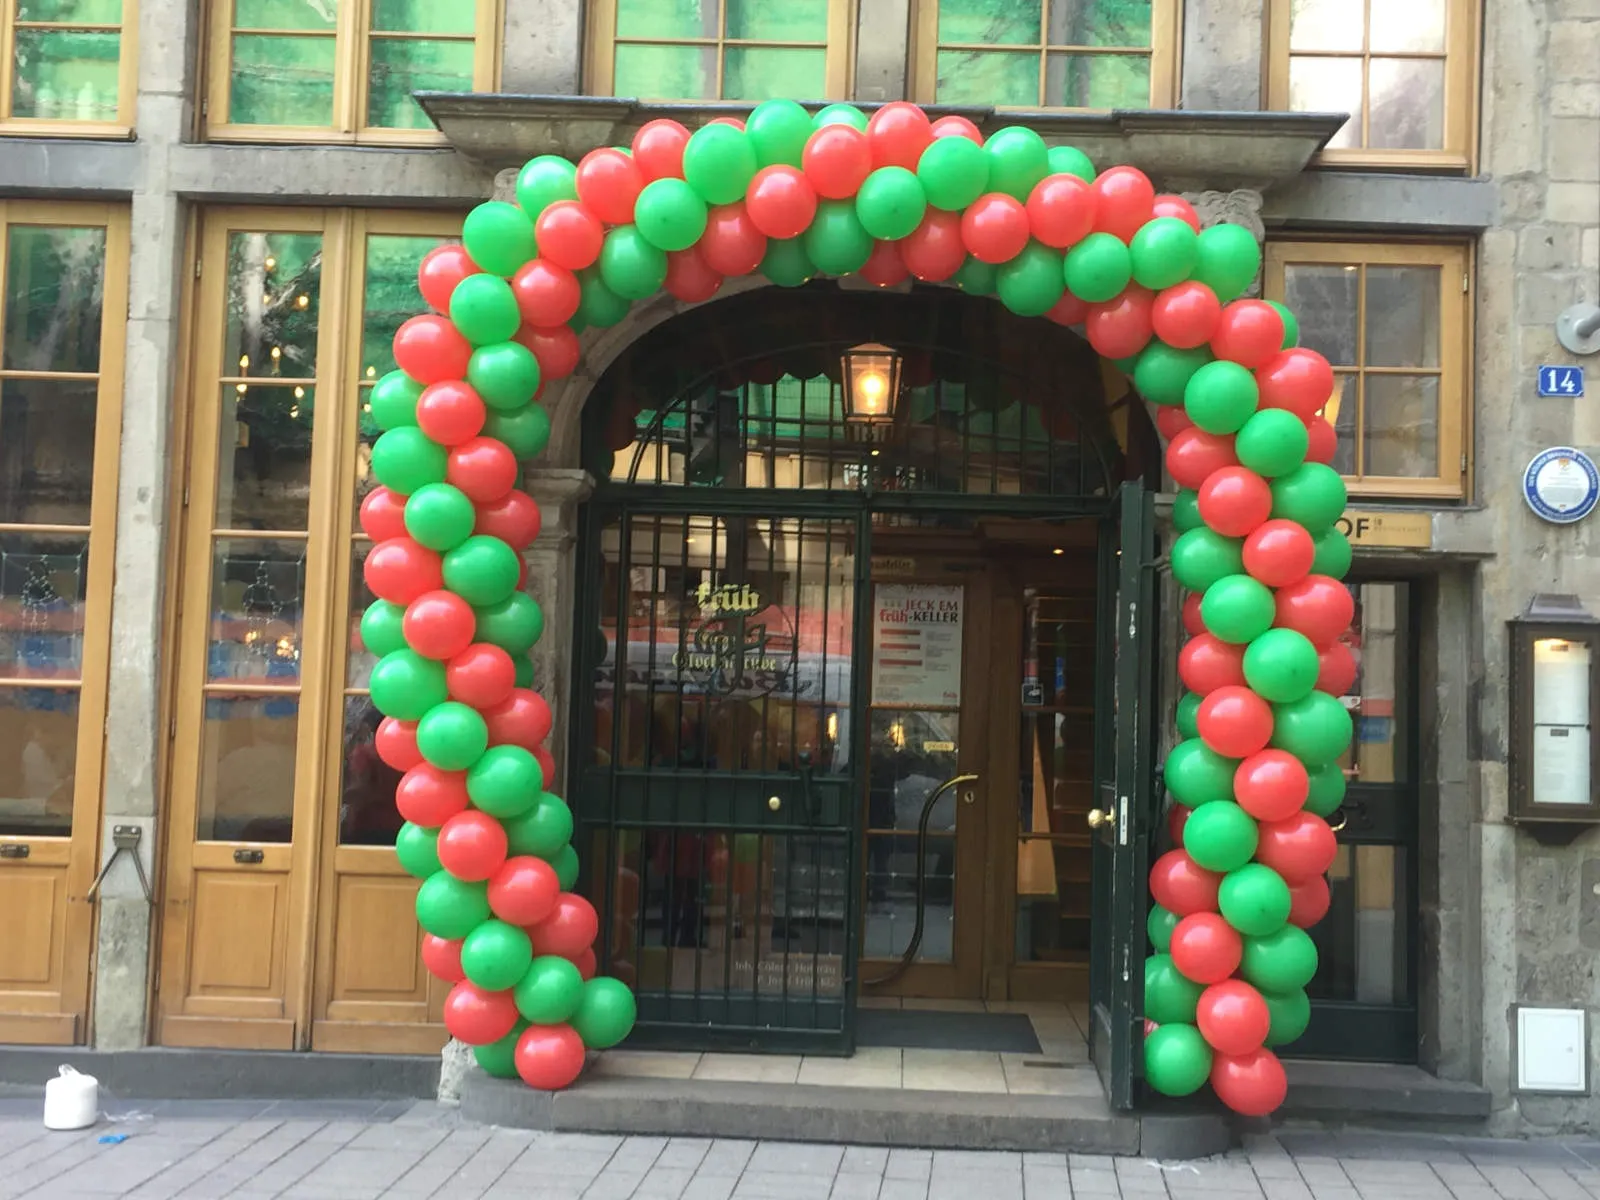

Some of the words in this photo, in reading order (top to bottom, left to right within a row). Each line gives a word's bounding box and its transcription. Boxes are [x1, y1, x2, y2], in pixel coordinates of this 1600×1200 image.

[1548, 369, 1576, 393] 14
[1333, 517, 1370, 538] OF
[905, 599, 935, 612] JECK
[939, 600, 958, 611] EM
